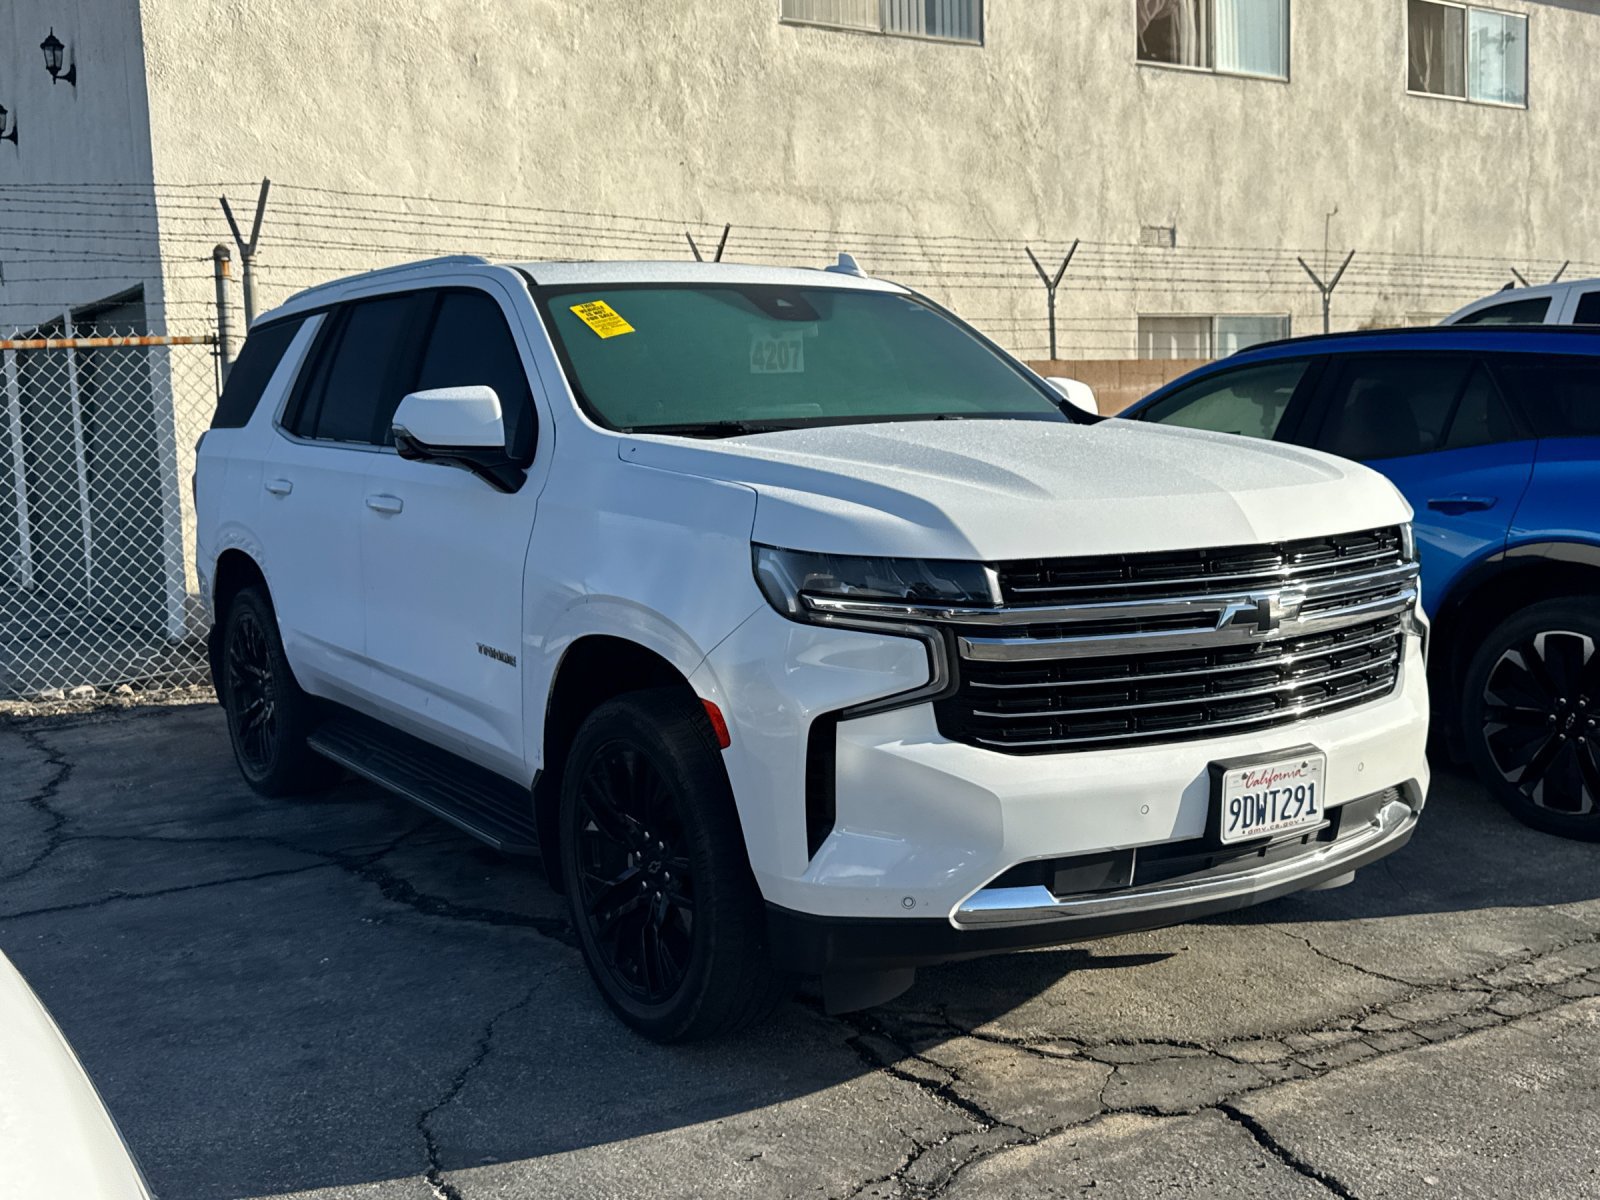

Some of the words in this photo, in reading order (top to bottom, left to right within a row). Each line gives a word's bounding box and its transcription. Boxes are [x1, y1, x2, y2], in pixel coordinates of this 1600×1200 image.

[751, 340, 802, 371] 4207
[1245, 767, 1307, 789] California
[1229, 782, 1317, 832] 9DWT291
[1248, 819, 1300, 835] dmv.ca.gov
